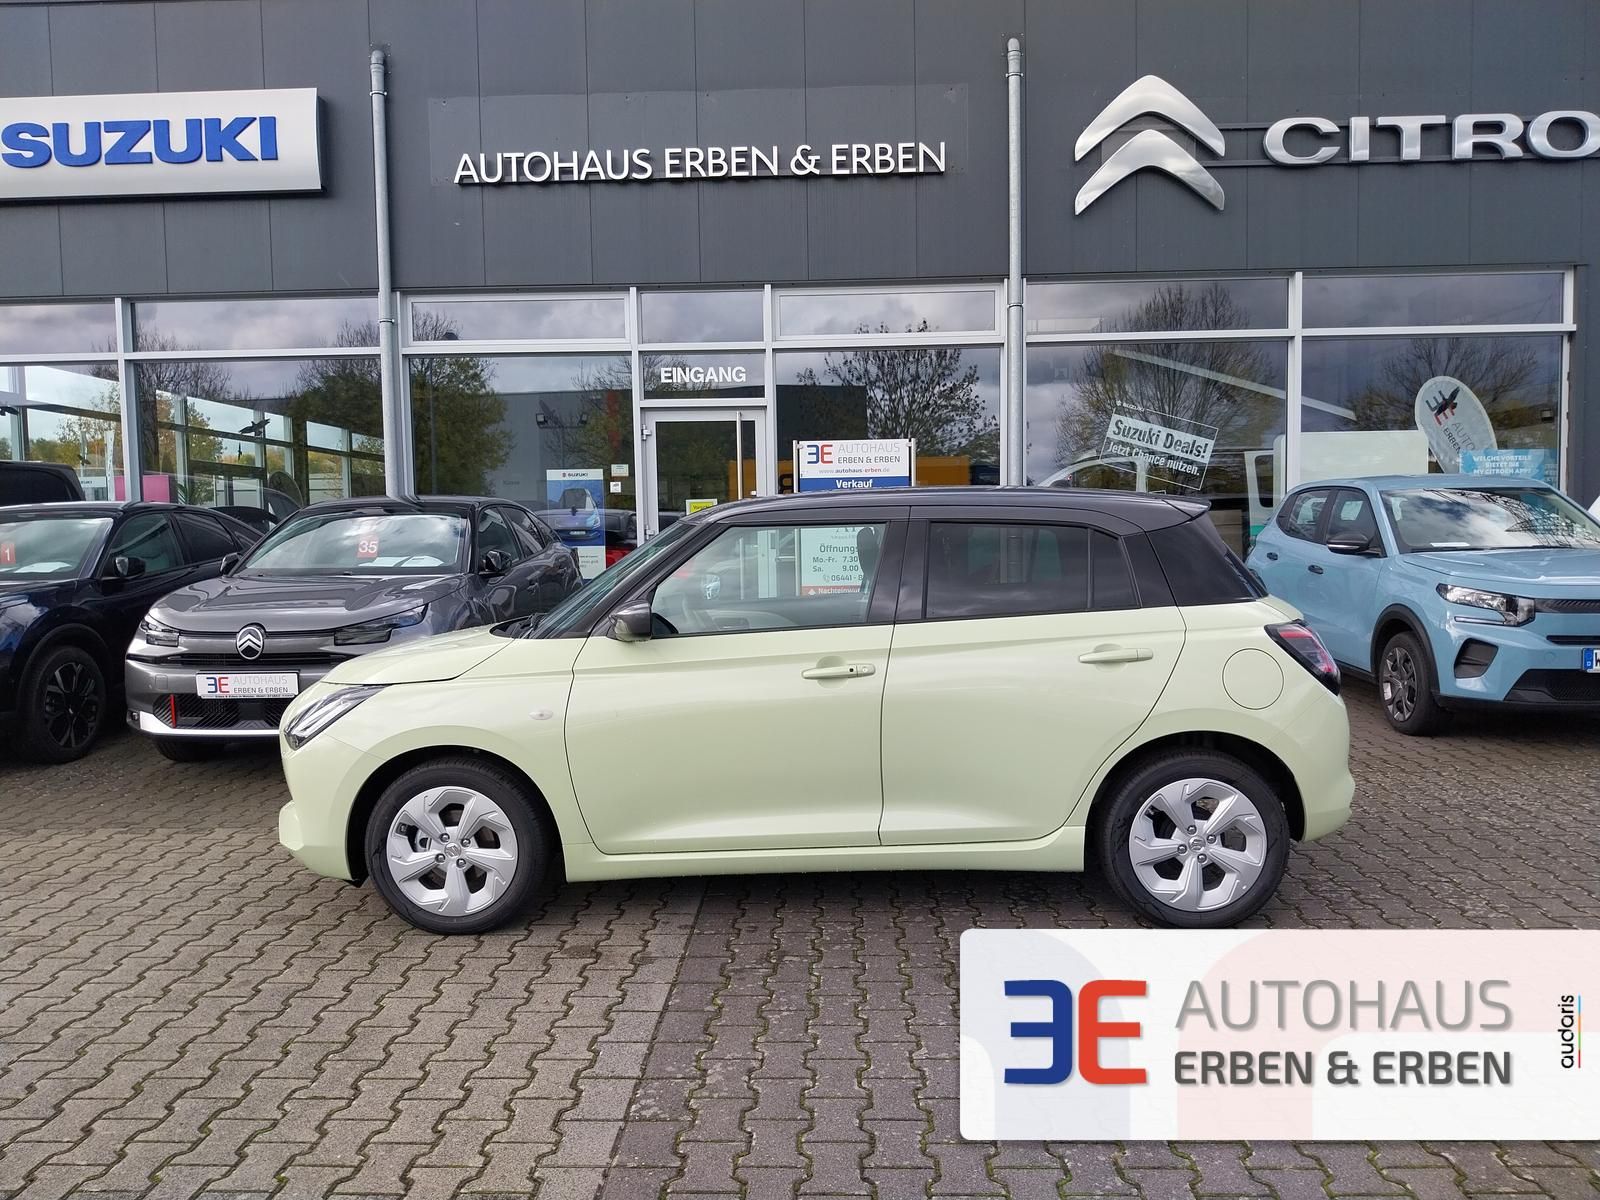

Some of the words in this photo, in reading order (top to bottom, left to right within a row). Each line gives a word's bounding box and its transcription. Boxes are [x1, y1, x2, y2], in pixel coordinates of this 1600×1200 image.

[1, 116, 278, 168] SUZUKI
[1263, 110, 1600, 165] CITRO
[454, 148, 653, 184] AUTOHAUS
[664, 146, 778, 179] ERBEN
[790, 144, 821, 176] &
[831, 141, 946, 175] ERBEN
[660, 365, 746, 384] EINGANG
[838, 442, 900, 454] AUTOHAUS
[1112, 419, 1162, 446] Suzuki
[1162, 432, 1209, 459] Deals!
[837, 456, 864, 464] ERBEN
[865, 456, 873, 464] &
[874, 455, 900, 463] ERBEN
[1107, 442, 1130, 457] Jetzt
[1131, 448, 1166, 466] Chance
[1166, 458, 1201, 476] nutzen.
[835, 478, 873, 488] Verkauf
[359, 540, 377, 553] 35
[233, 675, 288, 685] AUTOHAUS
